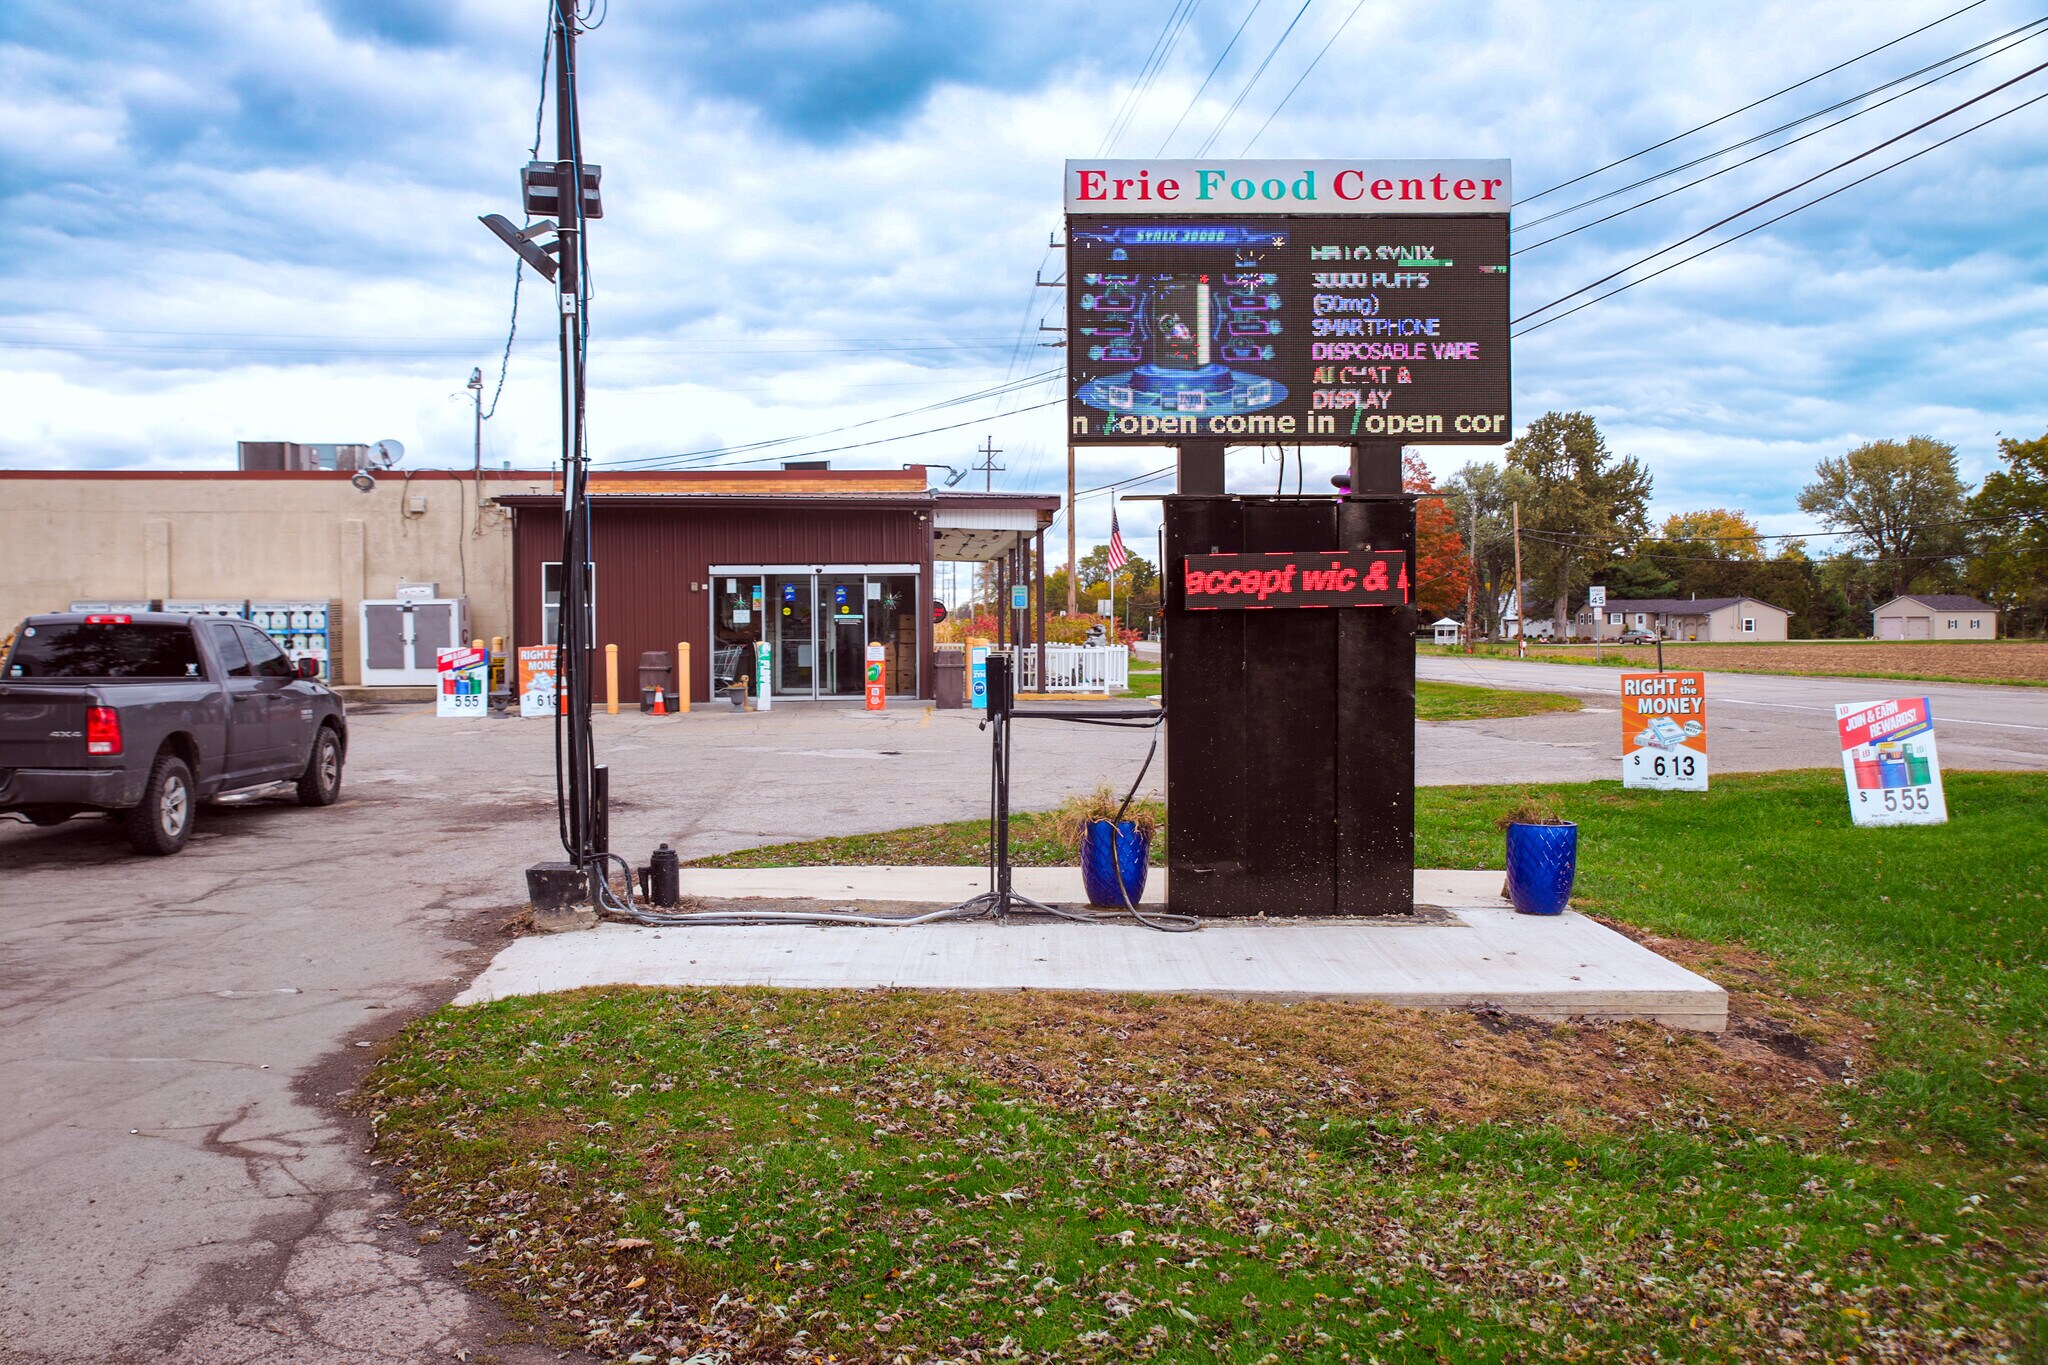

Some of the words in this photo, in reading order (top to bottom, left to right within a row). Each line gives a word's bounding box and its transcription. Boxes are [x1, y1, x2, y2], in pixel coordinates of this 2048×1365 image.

[1076, 170, 1180, 201] Erie
[1195, 169, 1318, 201] Food
[1333, 169, 1502, 201] Center
[1311, 318, 1441, 337] SMARTPHONE
[1311, 342, 1427, 361] DISPOSABLE
[1431, 342, 1480, 361] VAPE
[1396, 366, 1413, 385] &
[1312, 388, 1393, 410] DISPLAY
[1209, 415, 1297, 435] come
[1307, 410, 1335, 434] in
[1186, 563, 1296, 600] accept
[1302, 561, 1358, 592] wic
[1362, 560, 1389, 591] &
[521, 650, 549, 660] RIGHT
[528, 660, 557, 671] MONE
[1624, 678, 1678, 696] RIGHT
[1680, 686, 1698, 695] the
[1637, 697, 1704, 715] MONEY
[1845, 713, 1866, 732] JOIN
[1867, 709, 1875, 723] &
[1875, 700, 1899, 718] EARN
[1869, 708, 1917, 738] REWARDS!
[1633, 755, 1641, 766] $
[1860, 791, 1868, 802] $
